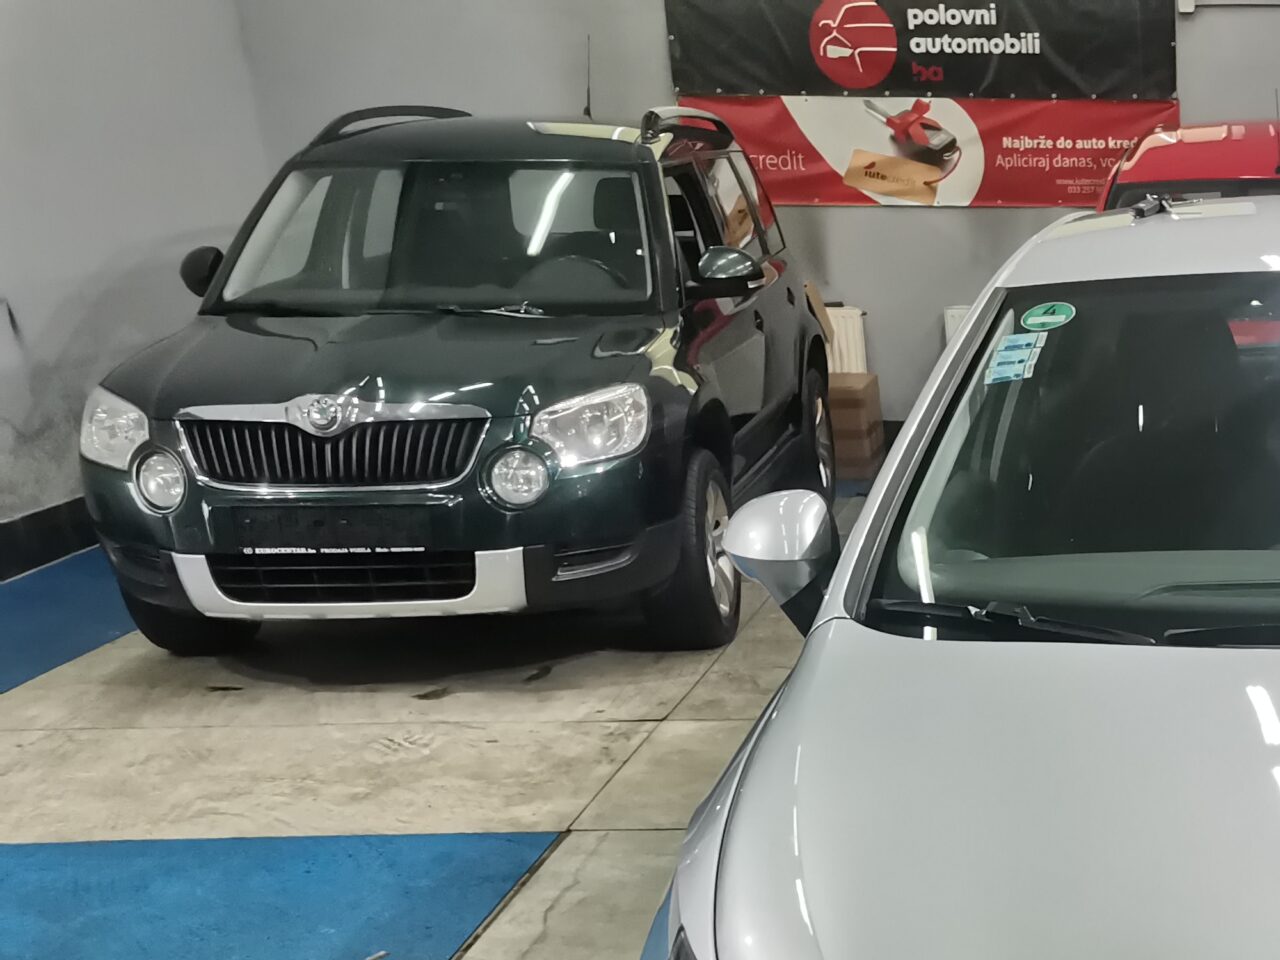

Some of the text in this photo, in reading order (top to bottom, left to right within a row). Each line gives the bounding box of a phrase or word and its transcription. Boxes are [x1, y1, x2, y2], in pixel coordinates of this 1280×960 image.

[907, 3, 997, 30] polovni
[909, 32, 1041, 54] automobili
[1002, 136, 1053, 150] Najbrže
[1056, 136, 1072, 149] do
[1075, 138, 1105, 149] auto
[995, 154, 1050, 172] Apliciraj
[1053, 154, 1097, 169] danas,
